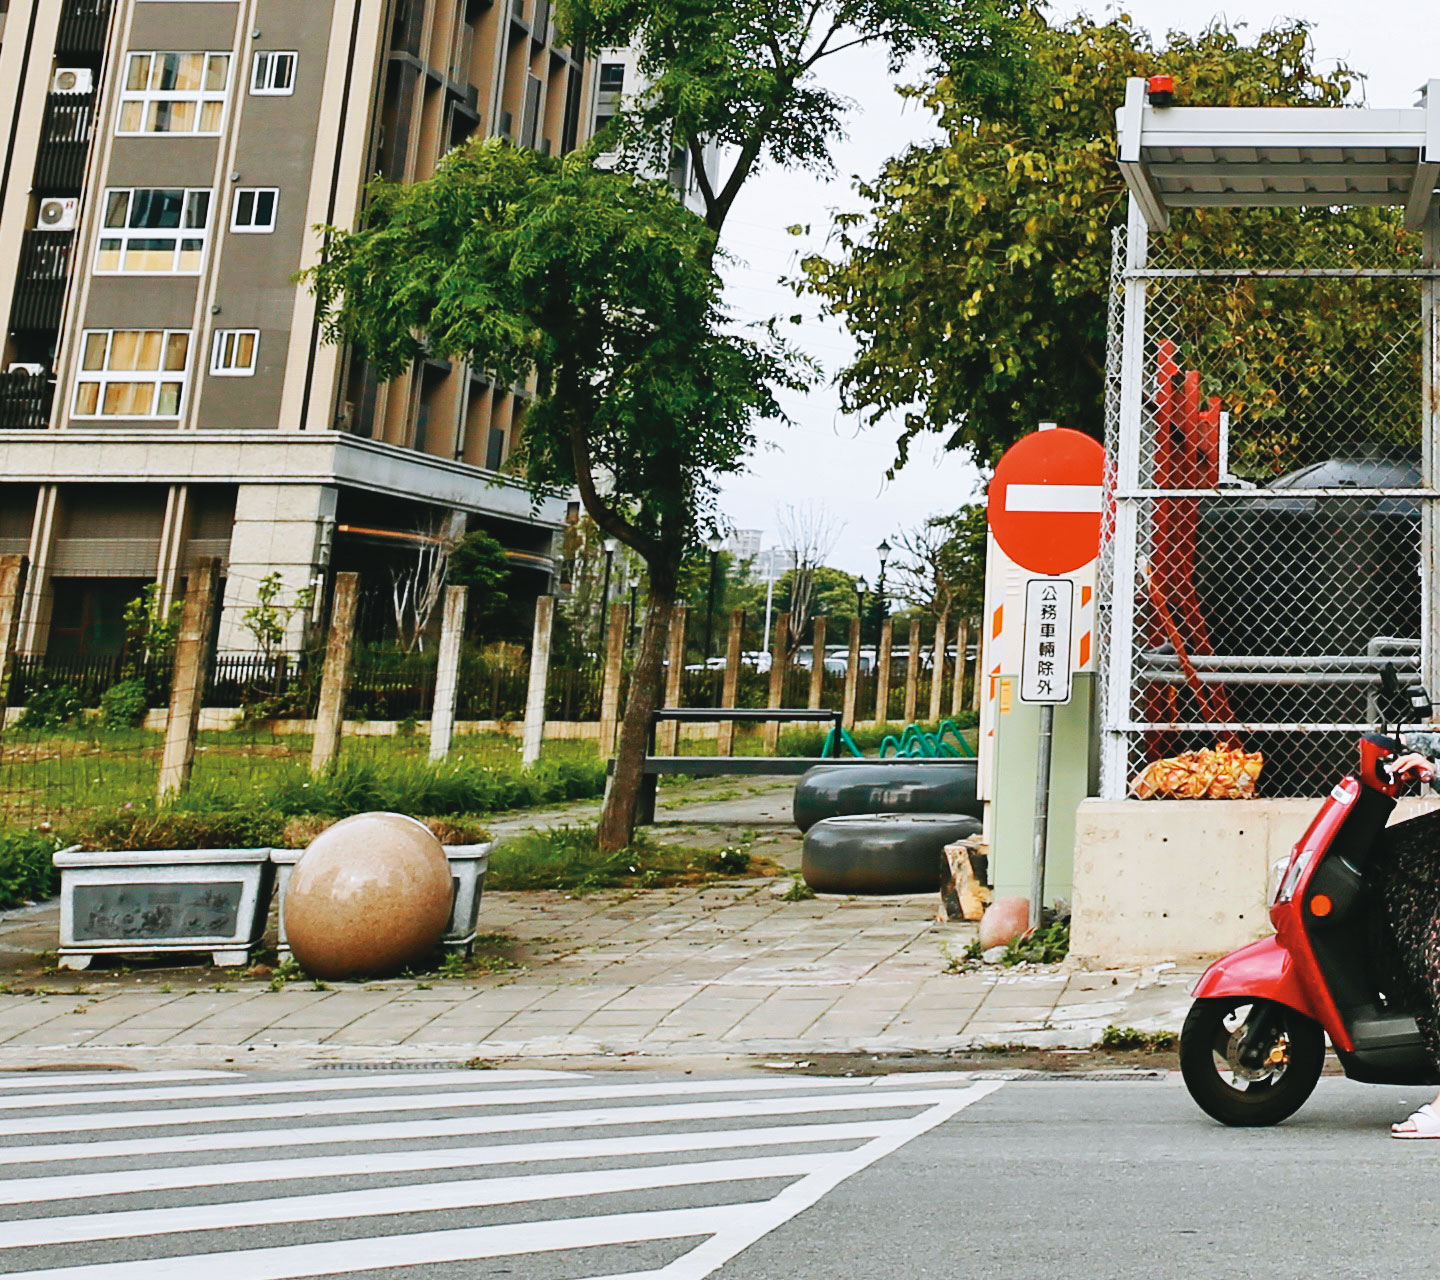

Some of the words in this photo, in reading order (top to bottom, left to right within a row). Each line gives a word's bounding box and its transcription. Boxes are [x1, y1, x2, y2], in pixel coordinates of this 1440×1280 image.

[1037, 585, 1058, 695] 公務車輛除外
